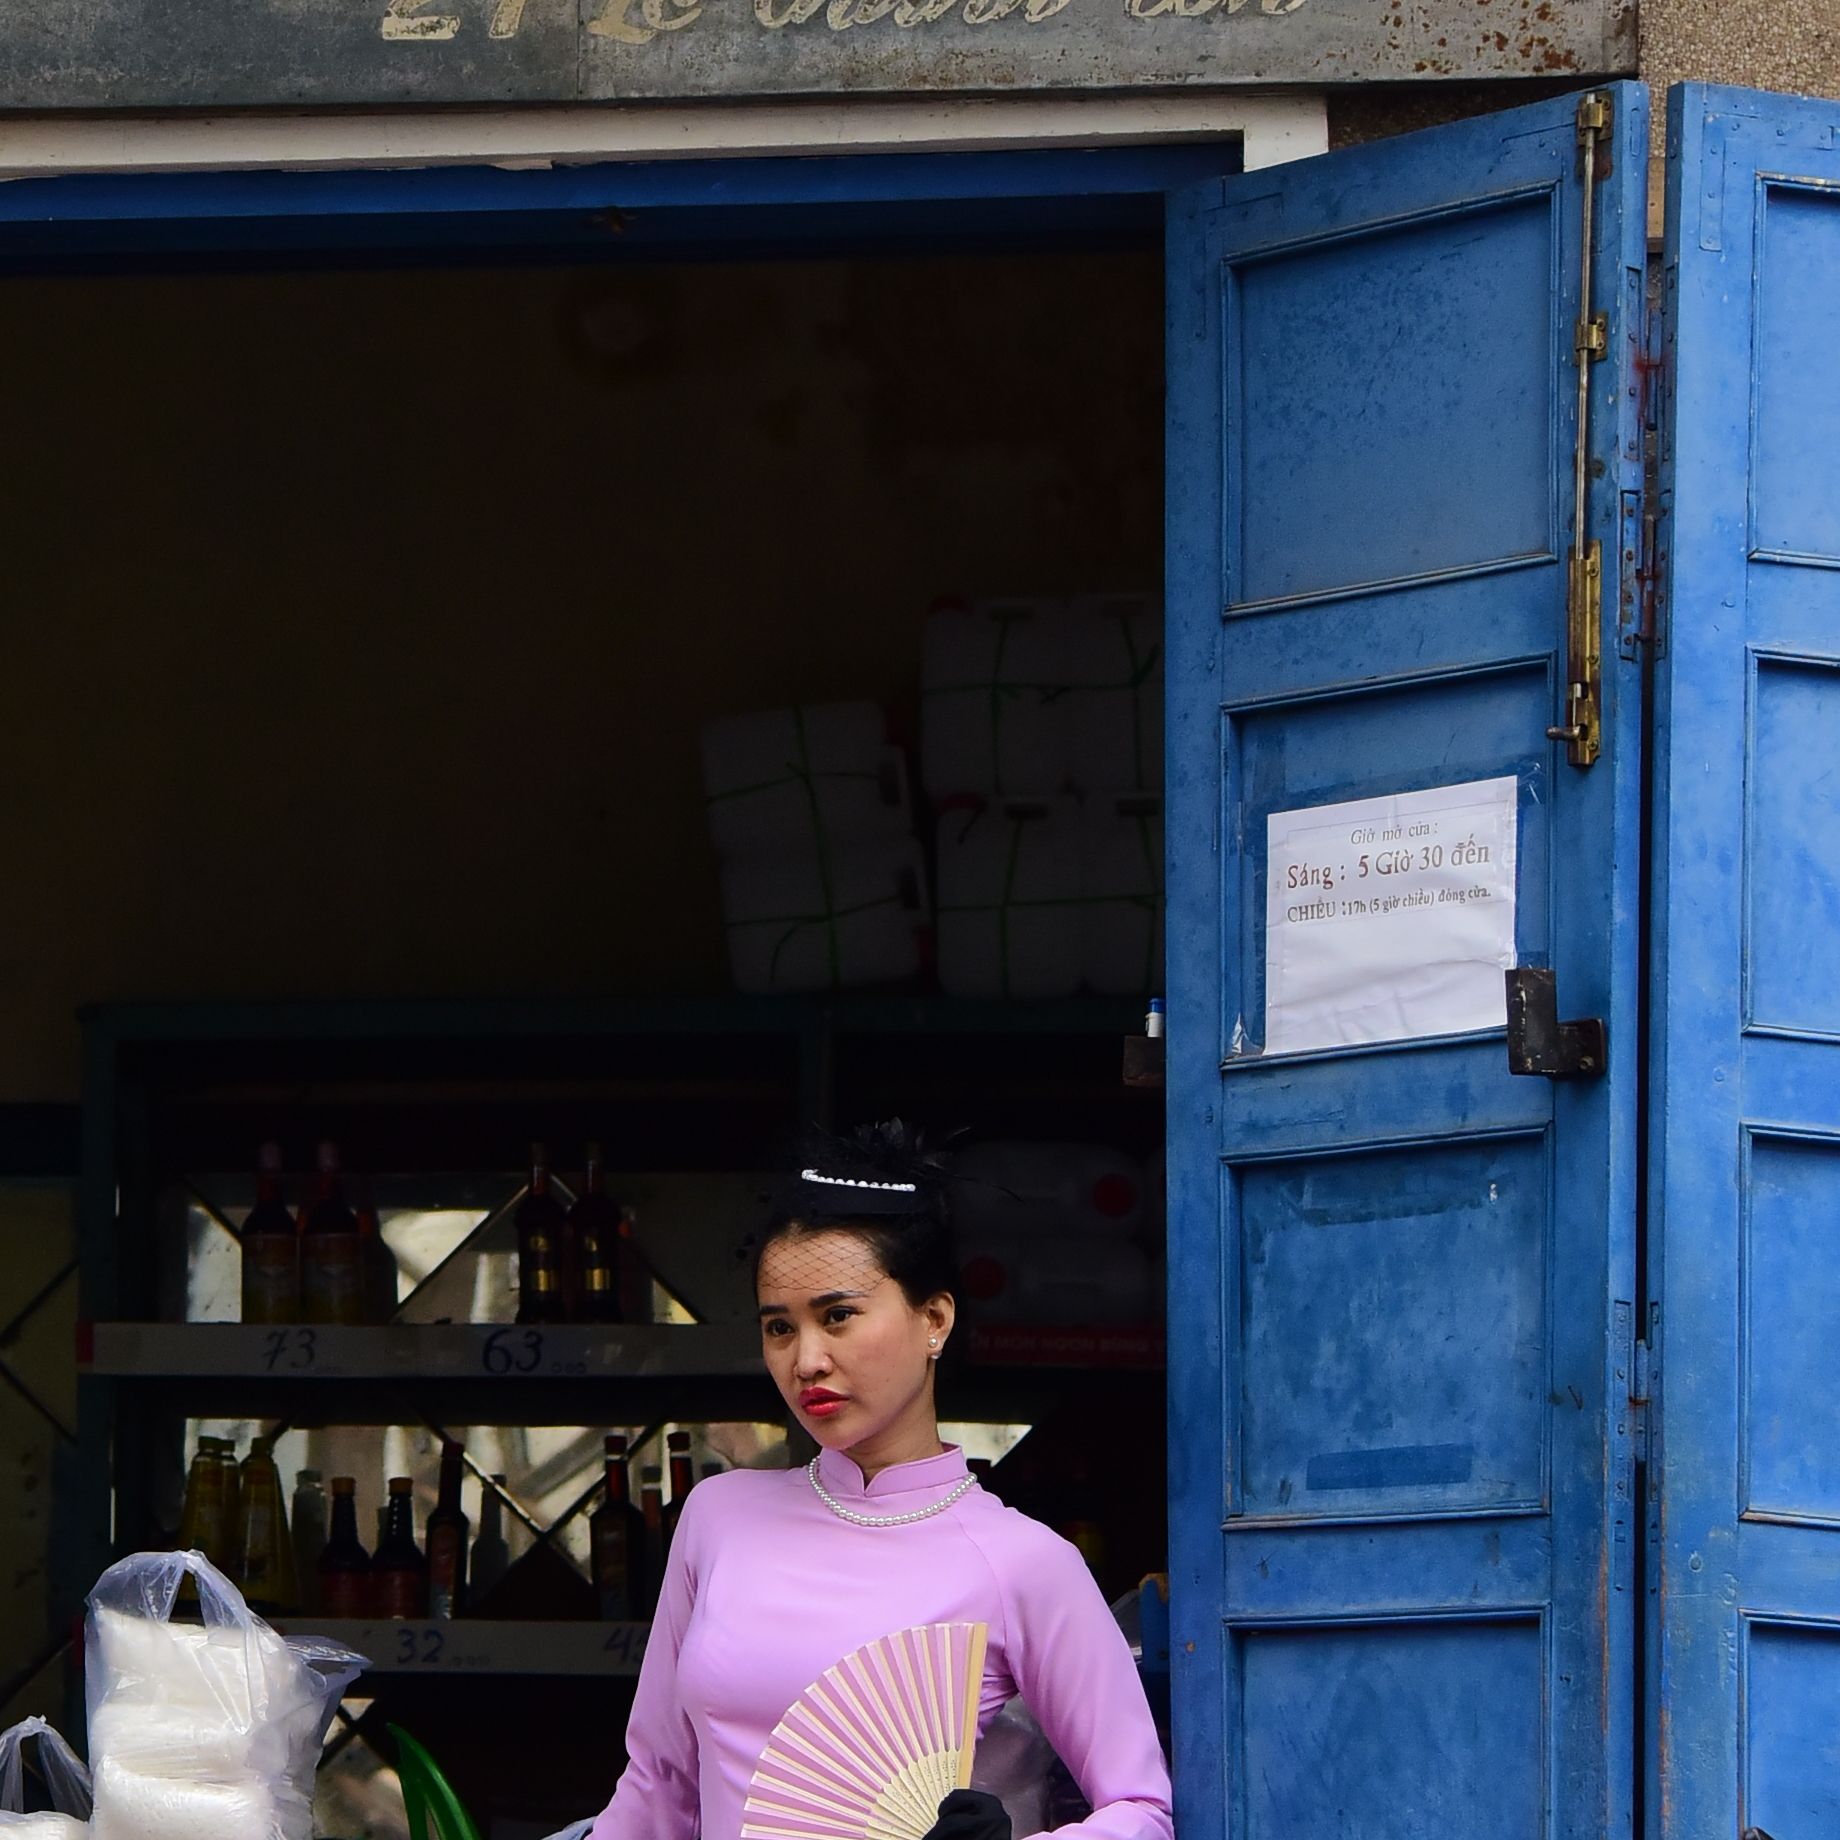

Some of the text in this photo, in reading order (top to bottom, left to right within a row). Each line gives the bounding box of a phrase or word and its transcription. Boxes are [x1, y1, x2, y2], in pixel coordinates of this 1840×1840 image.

[1350, 827, 1376, 845] Giờ
[1382, 823, 1402, 841] mở
[1287, 862, 1334, 890] Sáng
[1358, 854, 1369, 878] 5
[1375, 849, 1414, 875] Giờ
[1419, 844, 1443, 870] 30
[1451, 832, 1490, 866] đến
[1287, 895, 1336, 922] CHIỀU
[1438, 887, 1466, 904] đóng
[263, 1328, 317, 1370] 73
[482, 1328, 545, 1375] 63
[396, 1627, 445, 1664] 32
